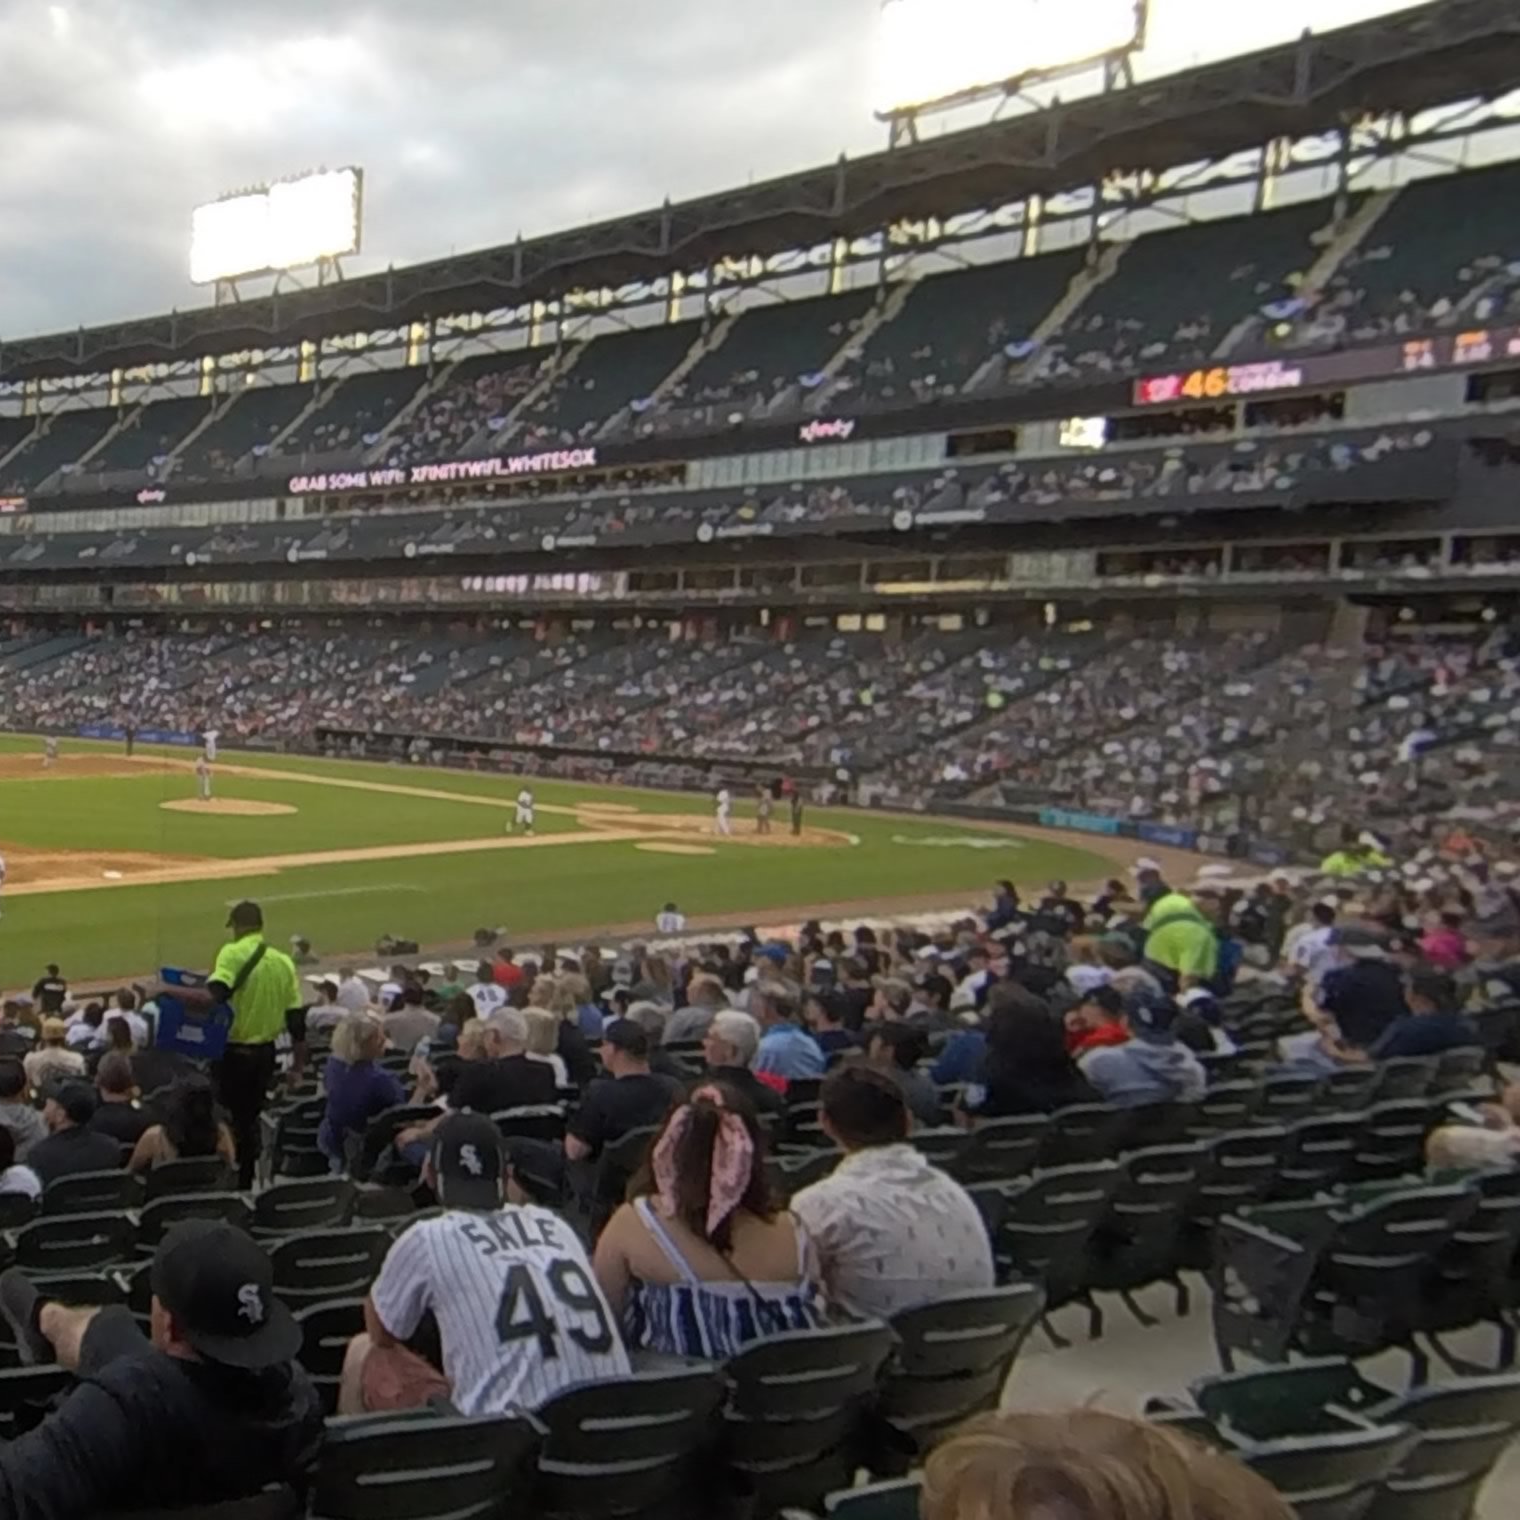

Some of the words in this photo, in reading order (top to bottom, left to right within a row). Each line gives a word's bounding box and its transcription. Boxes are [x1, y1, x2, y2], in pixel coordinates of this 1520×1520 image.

[1181, 367, 1226, 398] 46
[289, 474, 327, 493] GRAB
[328, 471, 367, 490] SOME
[460, 1211, 564, 1255] SALE
[494, 1257, 614, 1359] 49
